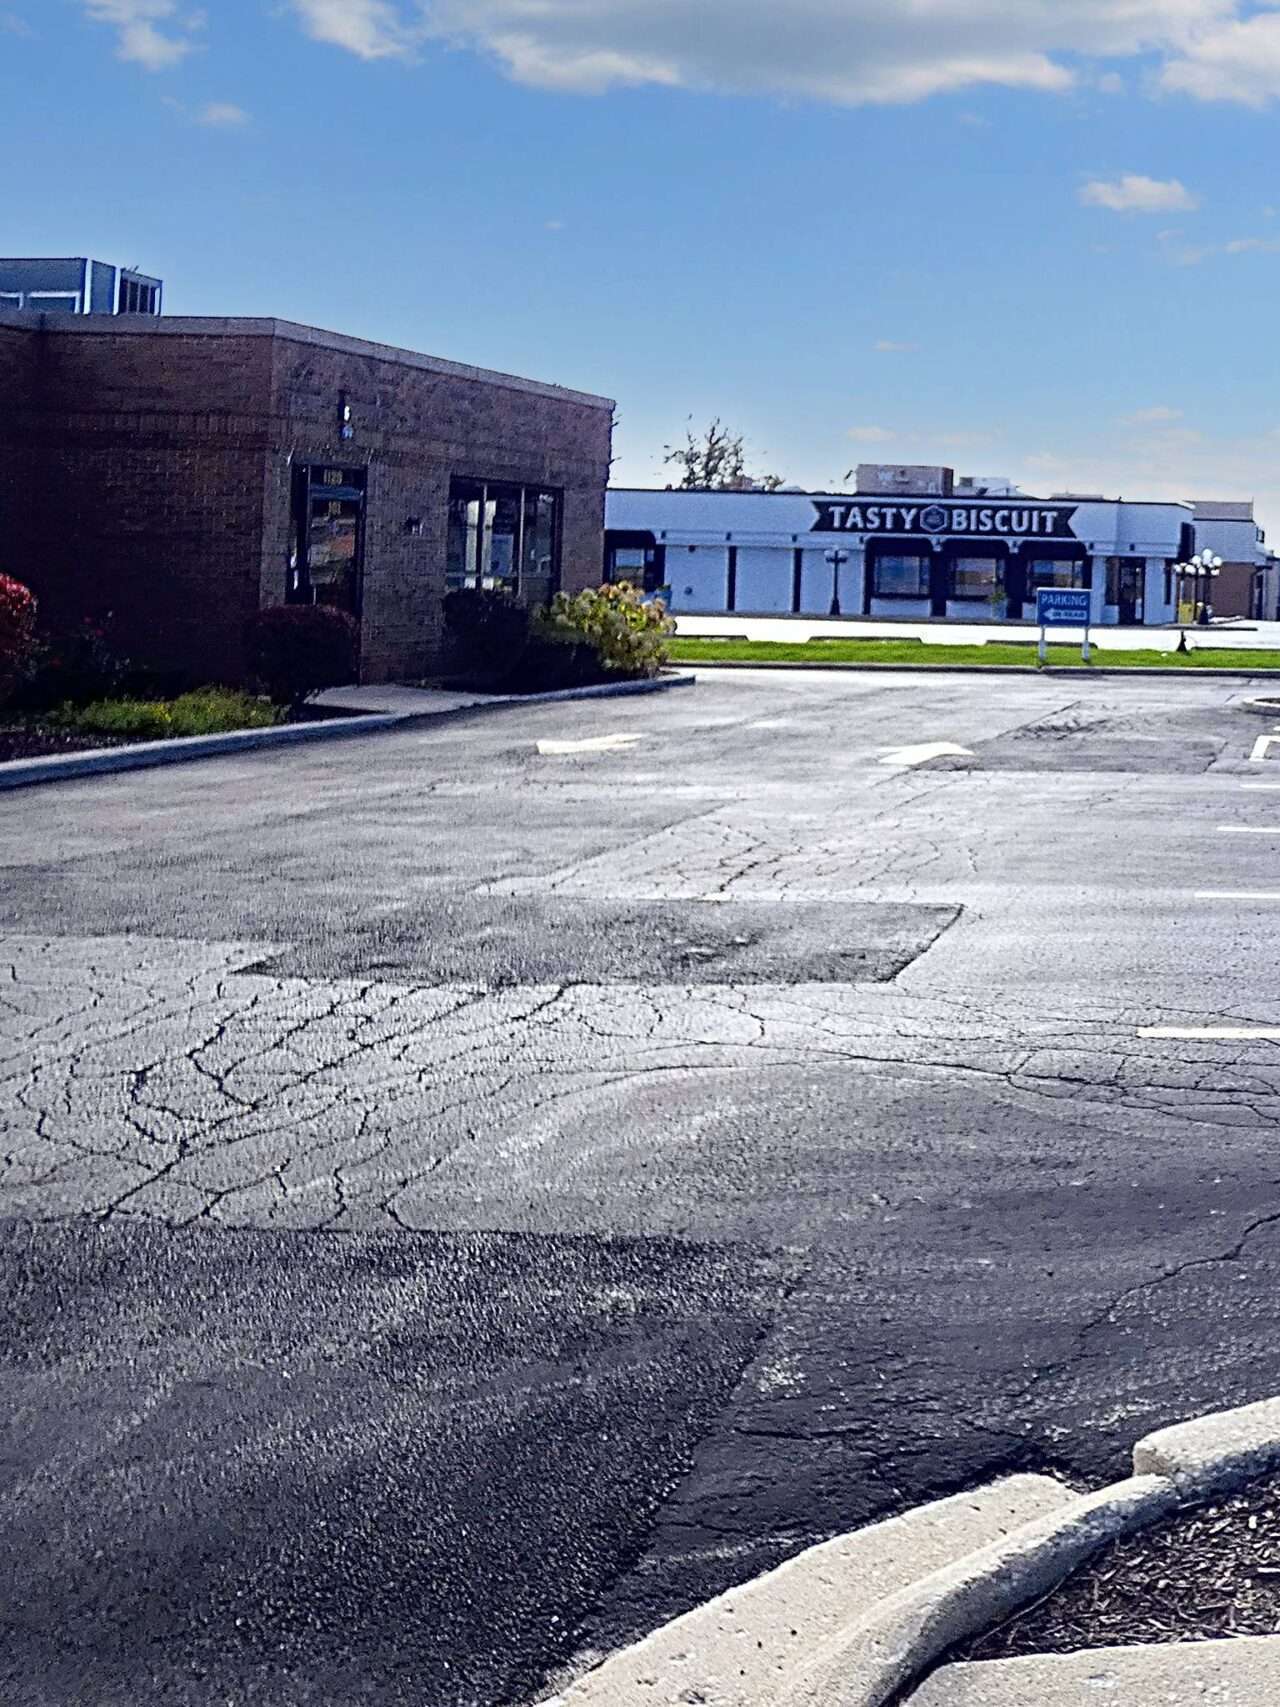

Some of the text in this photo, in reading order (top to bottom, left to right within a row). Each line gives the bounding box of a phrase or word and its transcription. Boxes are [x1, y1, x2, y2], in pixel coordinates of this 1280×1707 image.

[828, 505, 1059, 534] TASTY BISCUIT
[1040, 593, 1088, 607] PARKING
